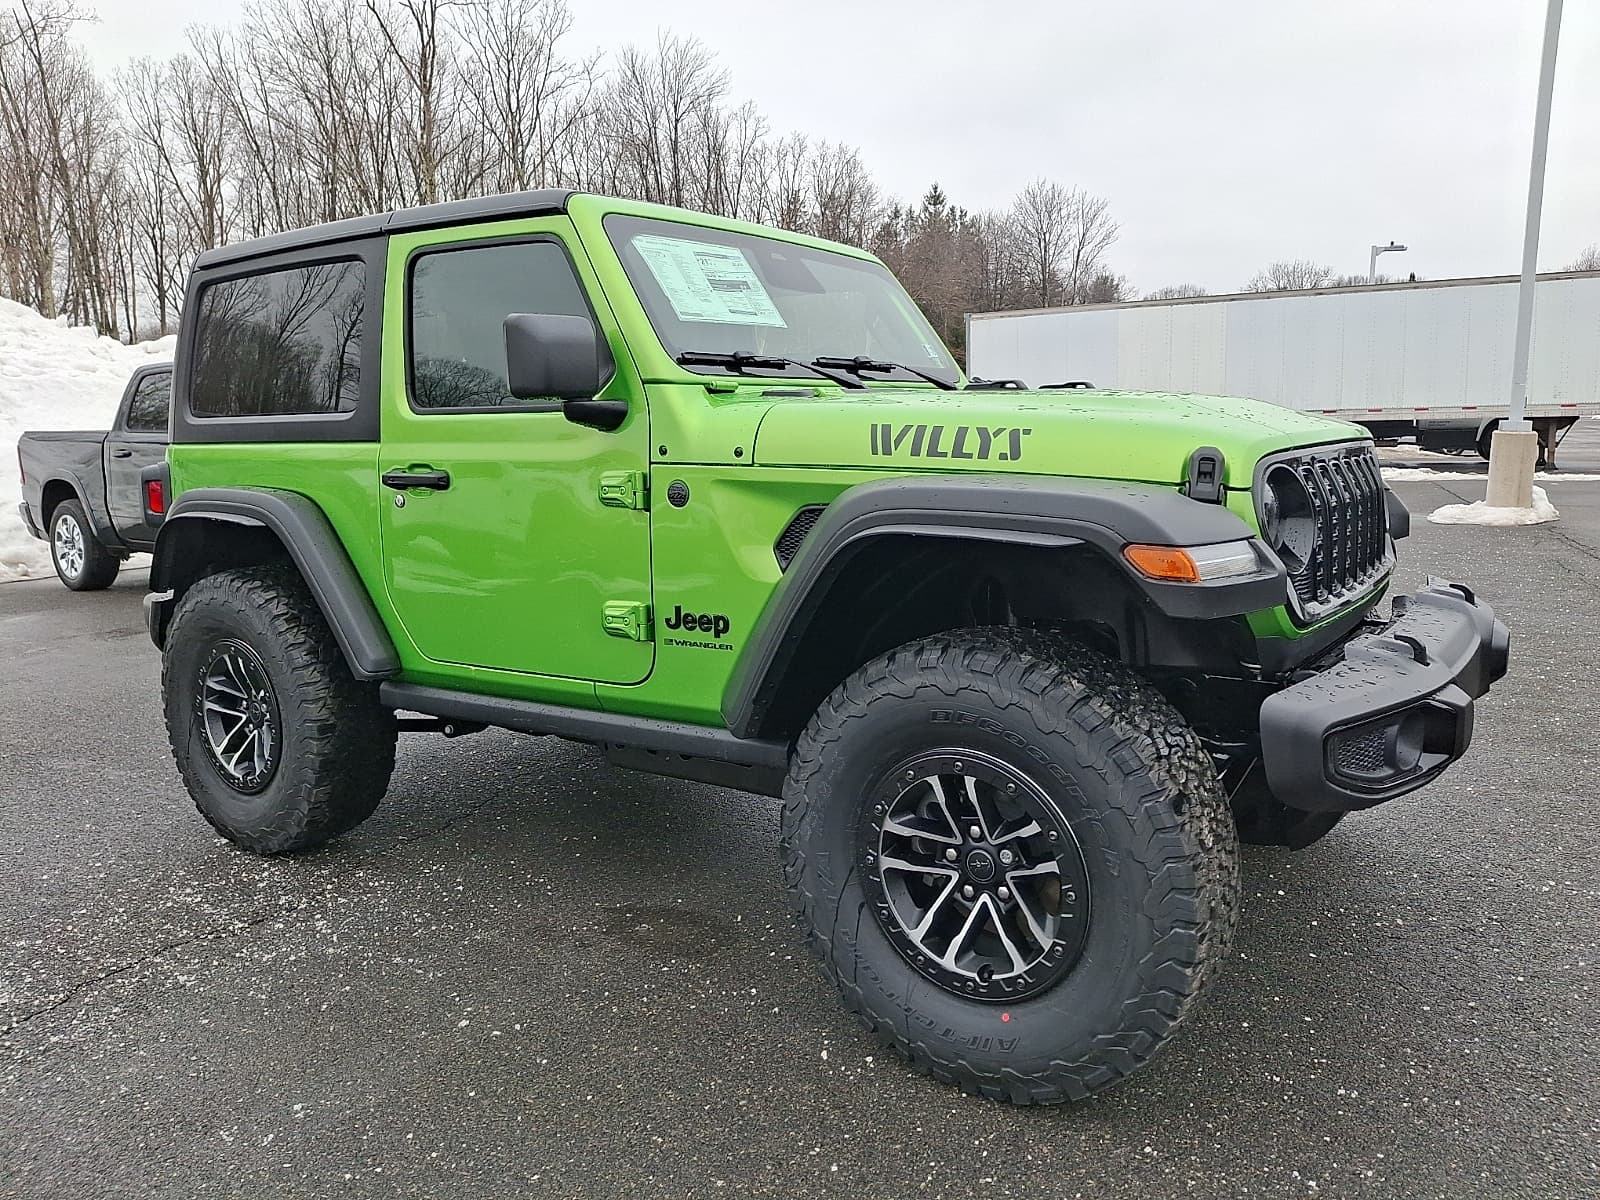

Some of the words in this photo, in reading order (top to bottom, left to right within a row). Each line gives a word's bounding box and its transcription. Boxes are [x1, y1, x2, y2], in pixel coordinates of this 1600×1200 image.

[871, 423, 1032, 461] WILLYS
[664, 605, 730, 638] Jeep
[674, 639, 733, 650] WRANGLER
